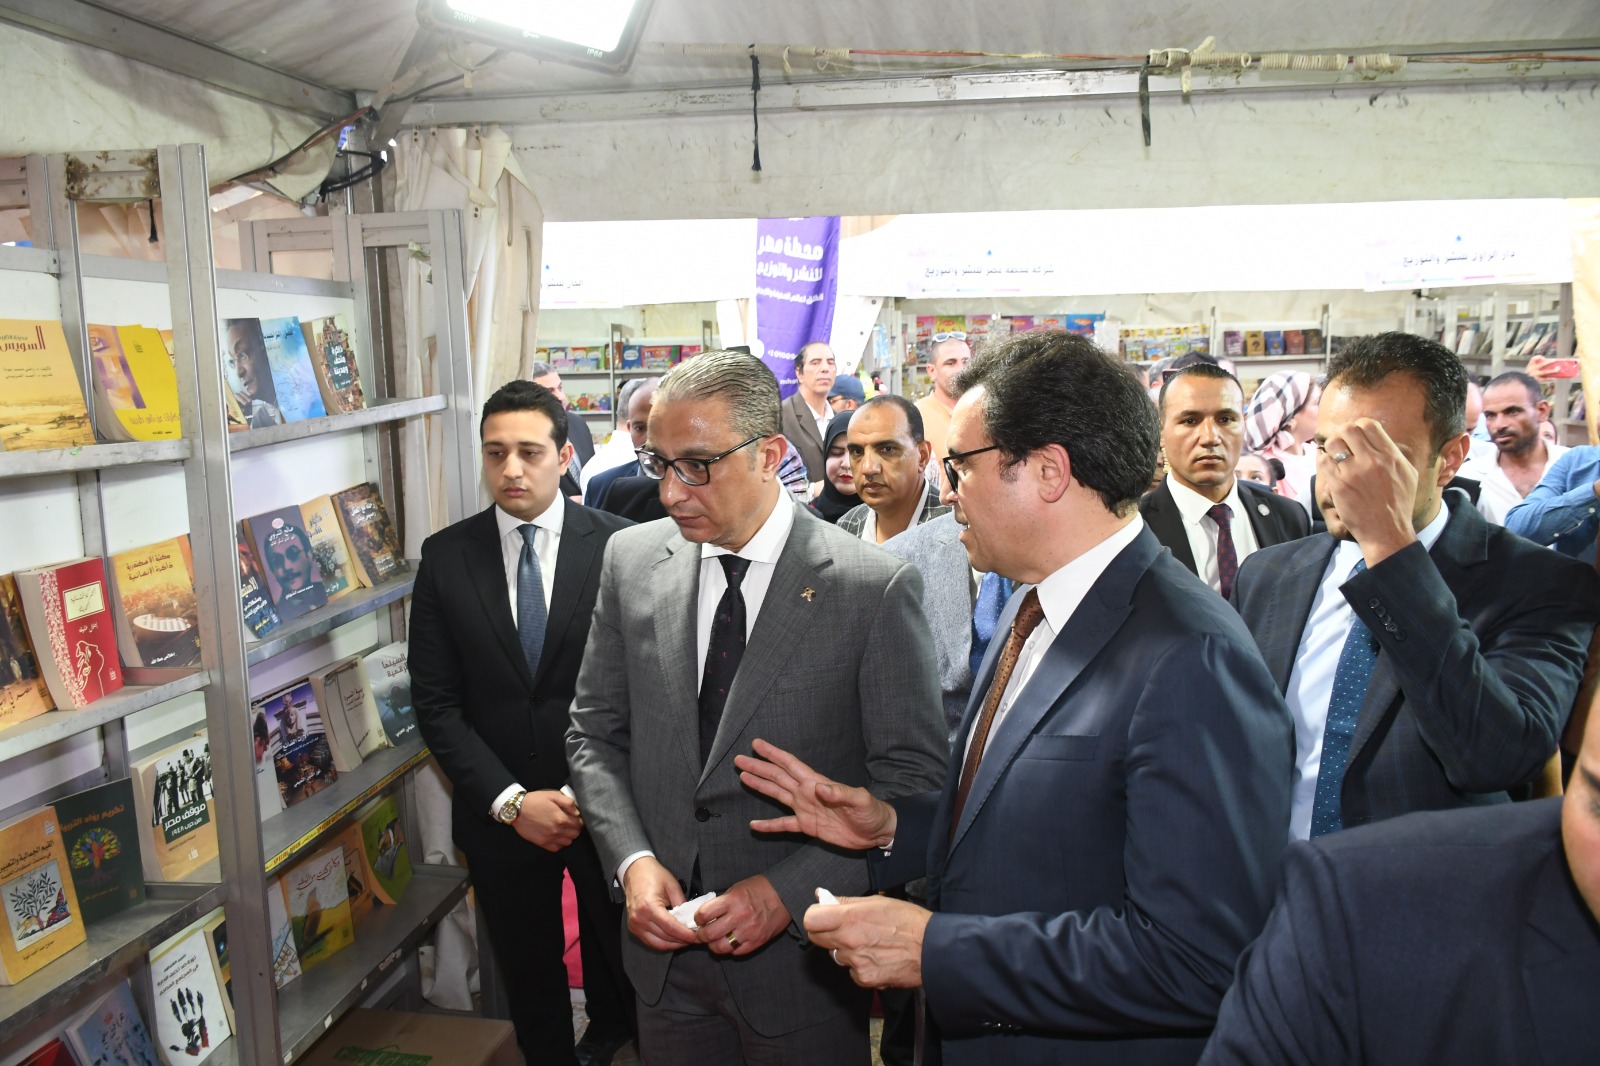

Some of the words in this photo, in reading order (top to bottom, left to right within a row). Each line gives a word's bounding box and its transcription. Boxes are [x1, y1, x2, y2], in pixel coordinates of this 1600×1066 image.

[454, 11, 477, 24] 200W
[757, 260, 792, 282] والتوزيع
[792, 264, 823, 283] للنشر
[0, 325, 46, 352] السويس
[154, 553, 171, 562] مكتبة
[381, 653, 407, 669] السينما
[102, 804, 124, 819] تكريم
[182, 803, 206, 820] موقف
[164, 815, 182, 832] مصر
[194, 817, 202, 826] من
